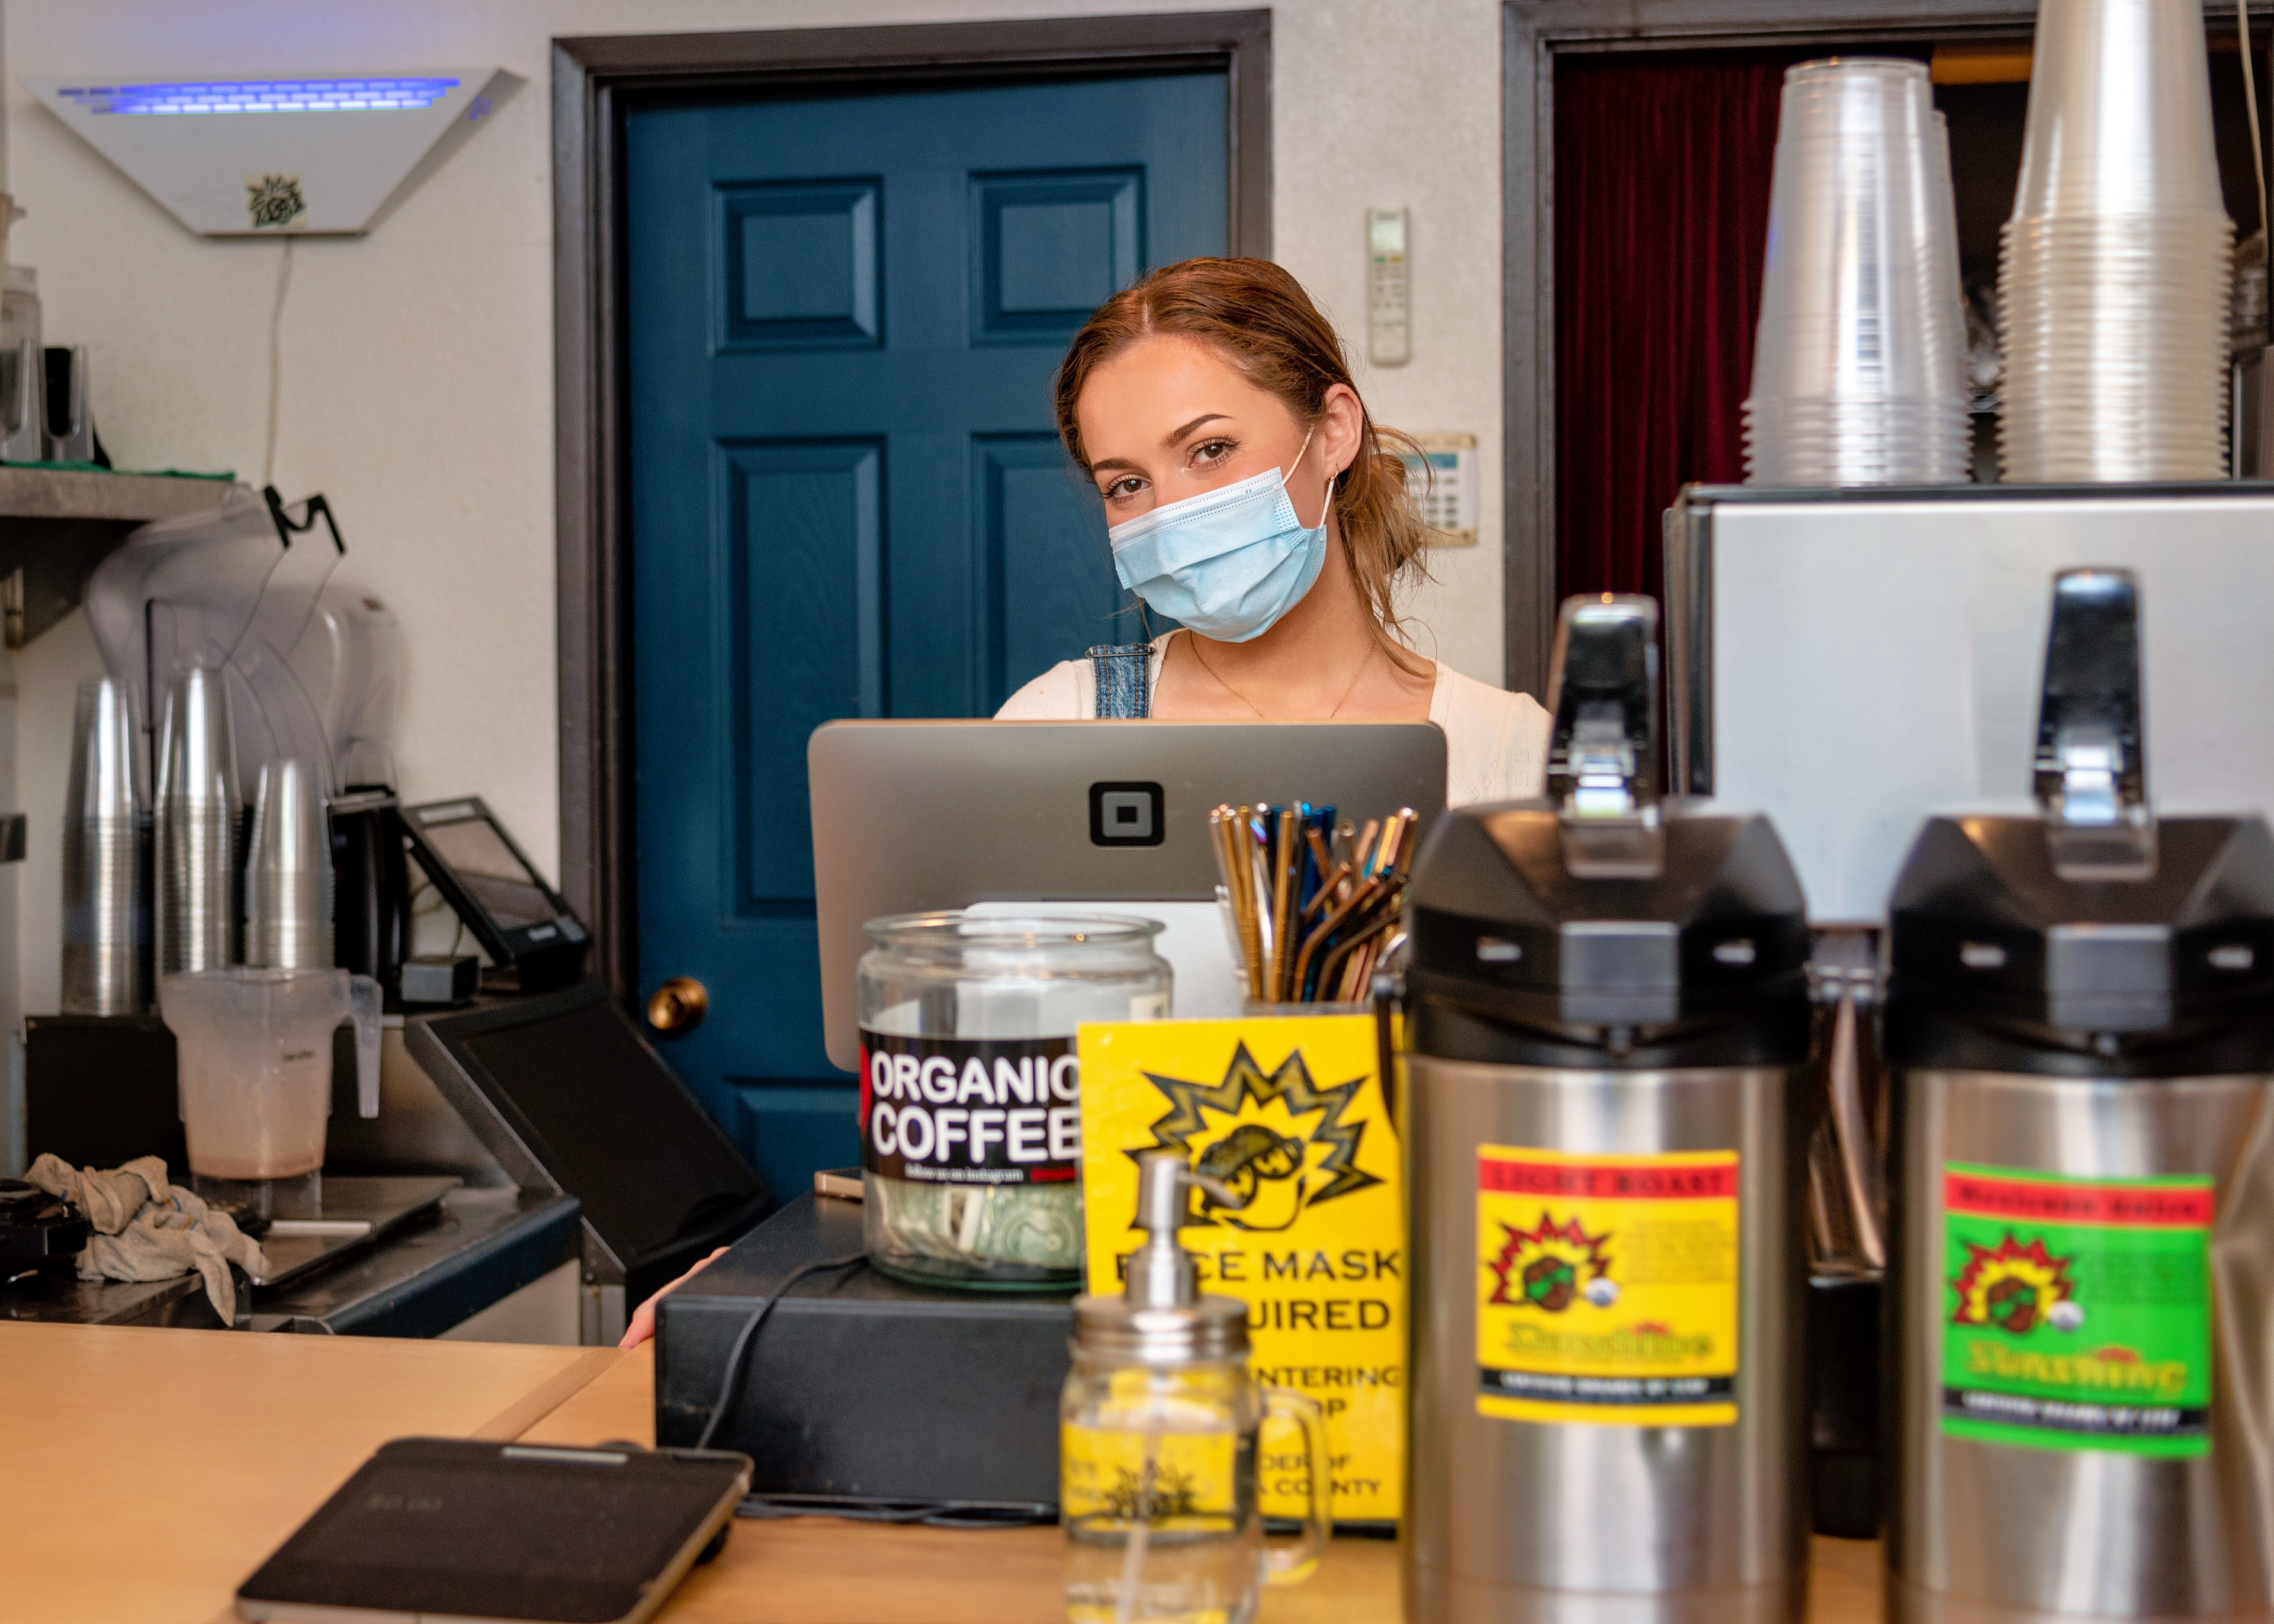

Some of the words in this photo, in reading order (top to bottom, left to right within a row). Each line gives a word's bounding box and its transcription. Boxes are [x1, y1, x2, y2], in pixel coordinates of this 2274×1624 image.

[871, 1051, 1080, 1104] ORGANIC
[872, 1102, 1081, 1163] COFFEE
[965, 1166, 1024, 1184] instagram
[1263, 1249, 1401, 1281] MASK
[1247, 1299, 1390, 1330] UIRED
[1257, 1365, 1402, 1388] NTERING
[1274, 1478, 1380, 1495] CONTY
